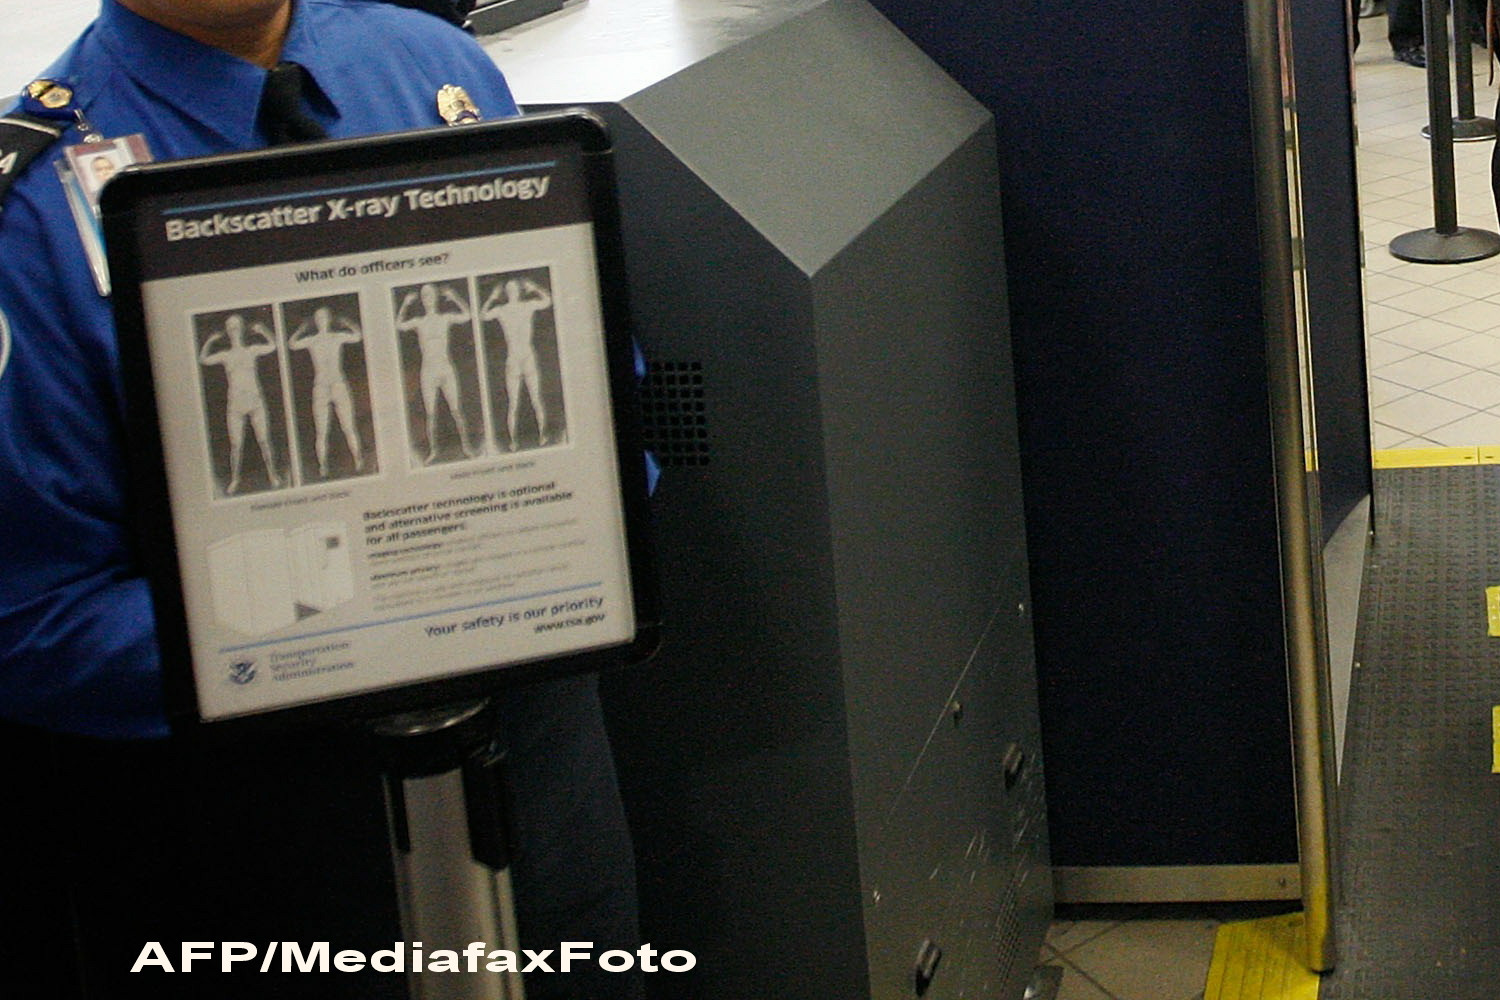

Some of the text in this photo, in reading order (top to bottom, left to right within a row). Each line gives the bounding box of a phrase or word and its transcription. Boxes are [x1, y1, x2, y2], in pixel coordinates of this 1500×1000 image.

[165, 175, 550, 242] Backscatter X-ray Technology
[295, 253, 449, 283] What do officers see?
[497, 489, 507, 500] is
[508, 481, 556, 498] optional
[364, 522, 386, 534] and
[454, 502, 508, 518] screening
[510, 500, 520, 510] is
[366, 535, 384, 546] for
[424, 597, 605, 638] Your safety is our priority
